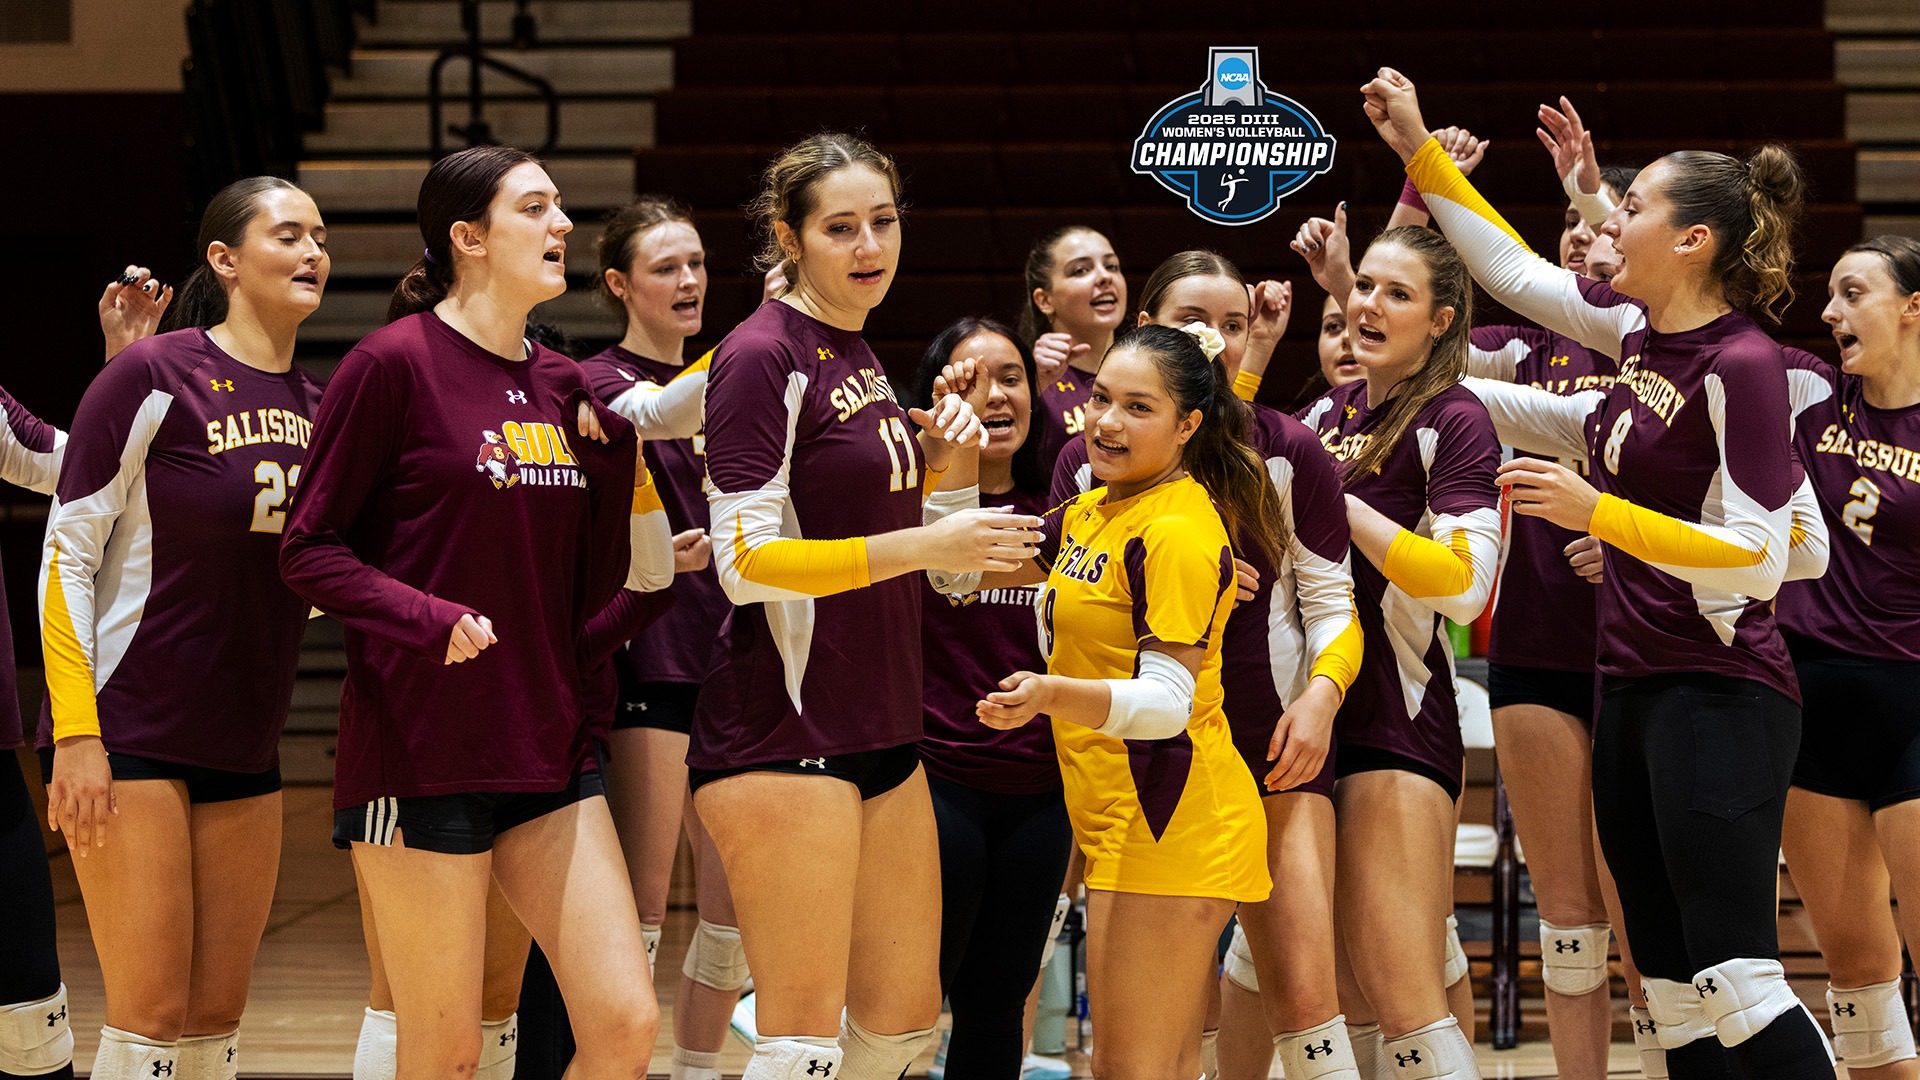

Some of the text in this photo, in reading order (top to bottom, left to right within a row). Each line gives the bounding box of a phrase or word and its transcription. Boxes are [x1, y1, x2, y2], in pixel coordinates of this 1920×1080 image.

[878, 416, 918, 492] 17
[1592, 408, 1633, 476] 8
[249, 460, 302, 534] 2
[1842, 475, 1881, 547] 2
[980, 588, 1038, 606] VOLLEY
